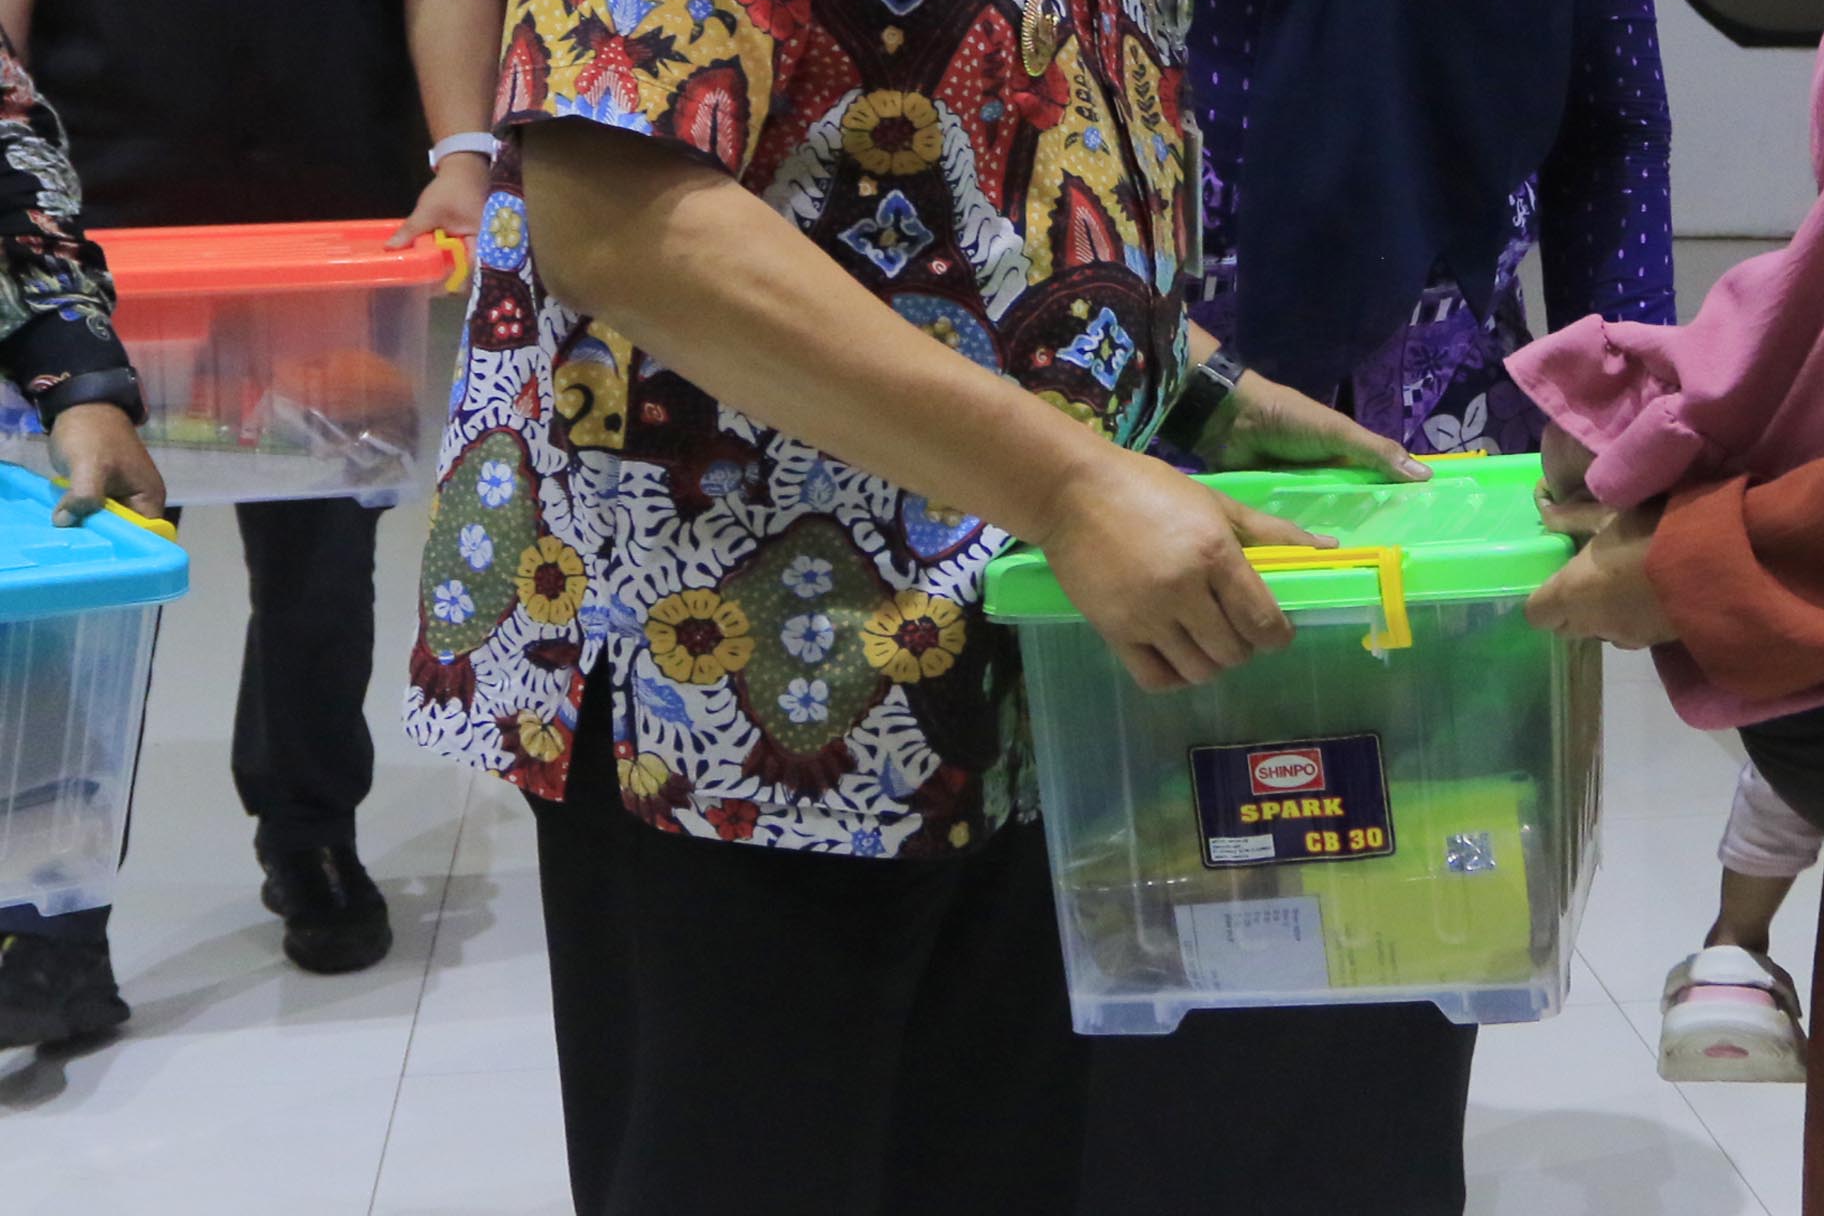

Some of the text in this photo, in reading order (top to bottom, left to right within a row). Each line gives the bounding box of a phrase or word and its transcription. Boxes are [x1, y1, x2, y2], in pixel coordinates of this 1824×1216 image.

[1258, 763, 1316, 780] SHINPO
[1240, 797, 1345, 824] SPARK
[1305, 827, 1384, 854] CB 30
